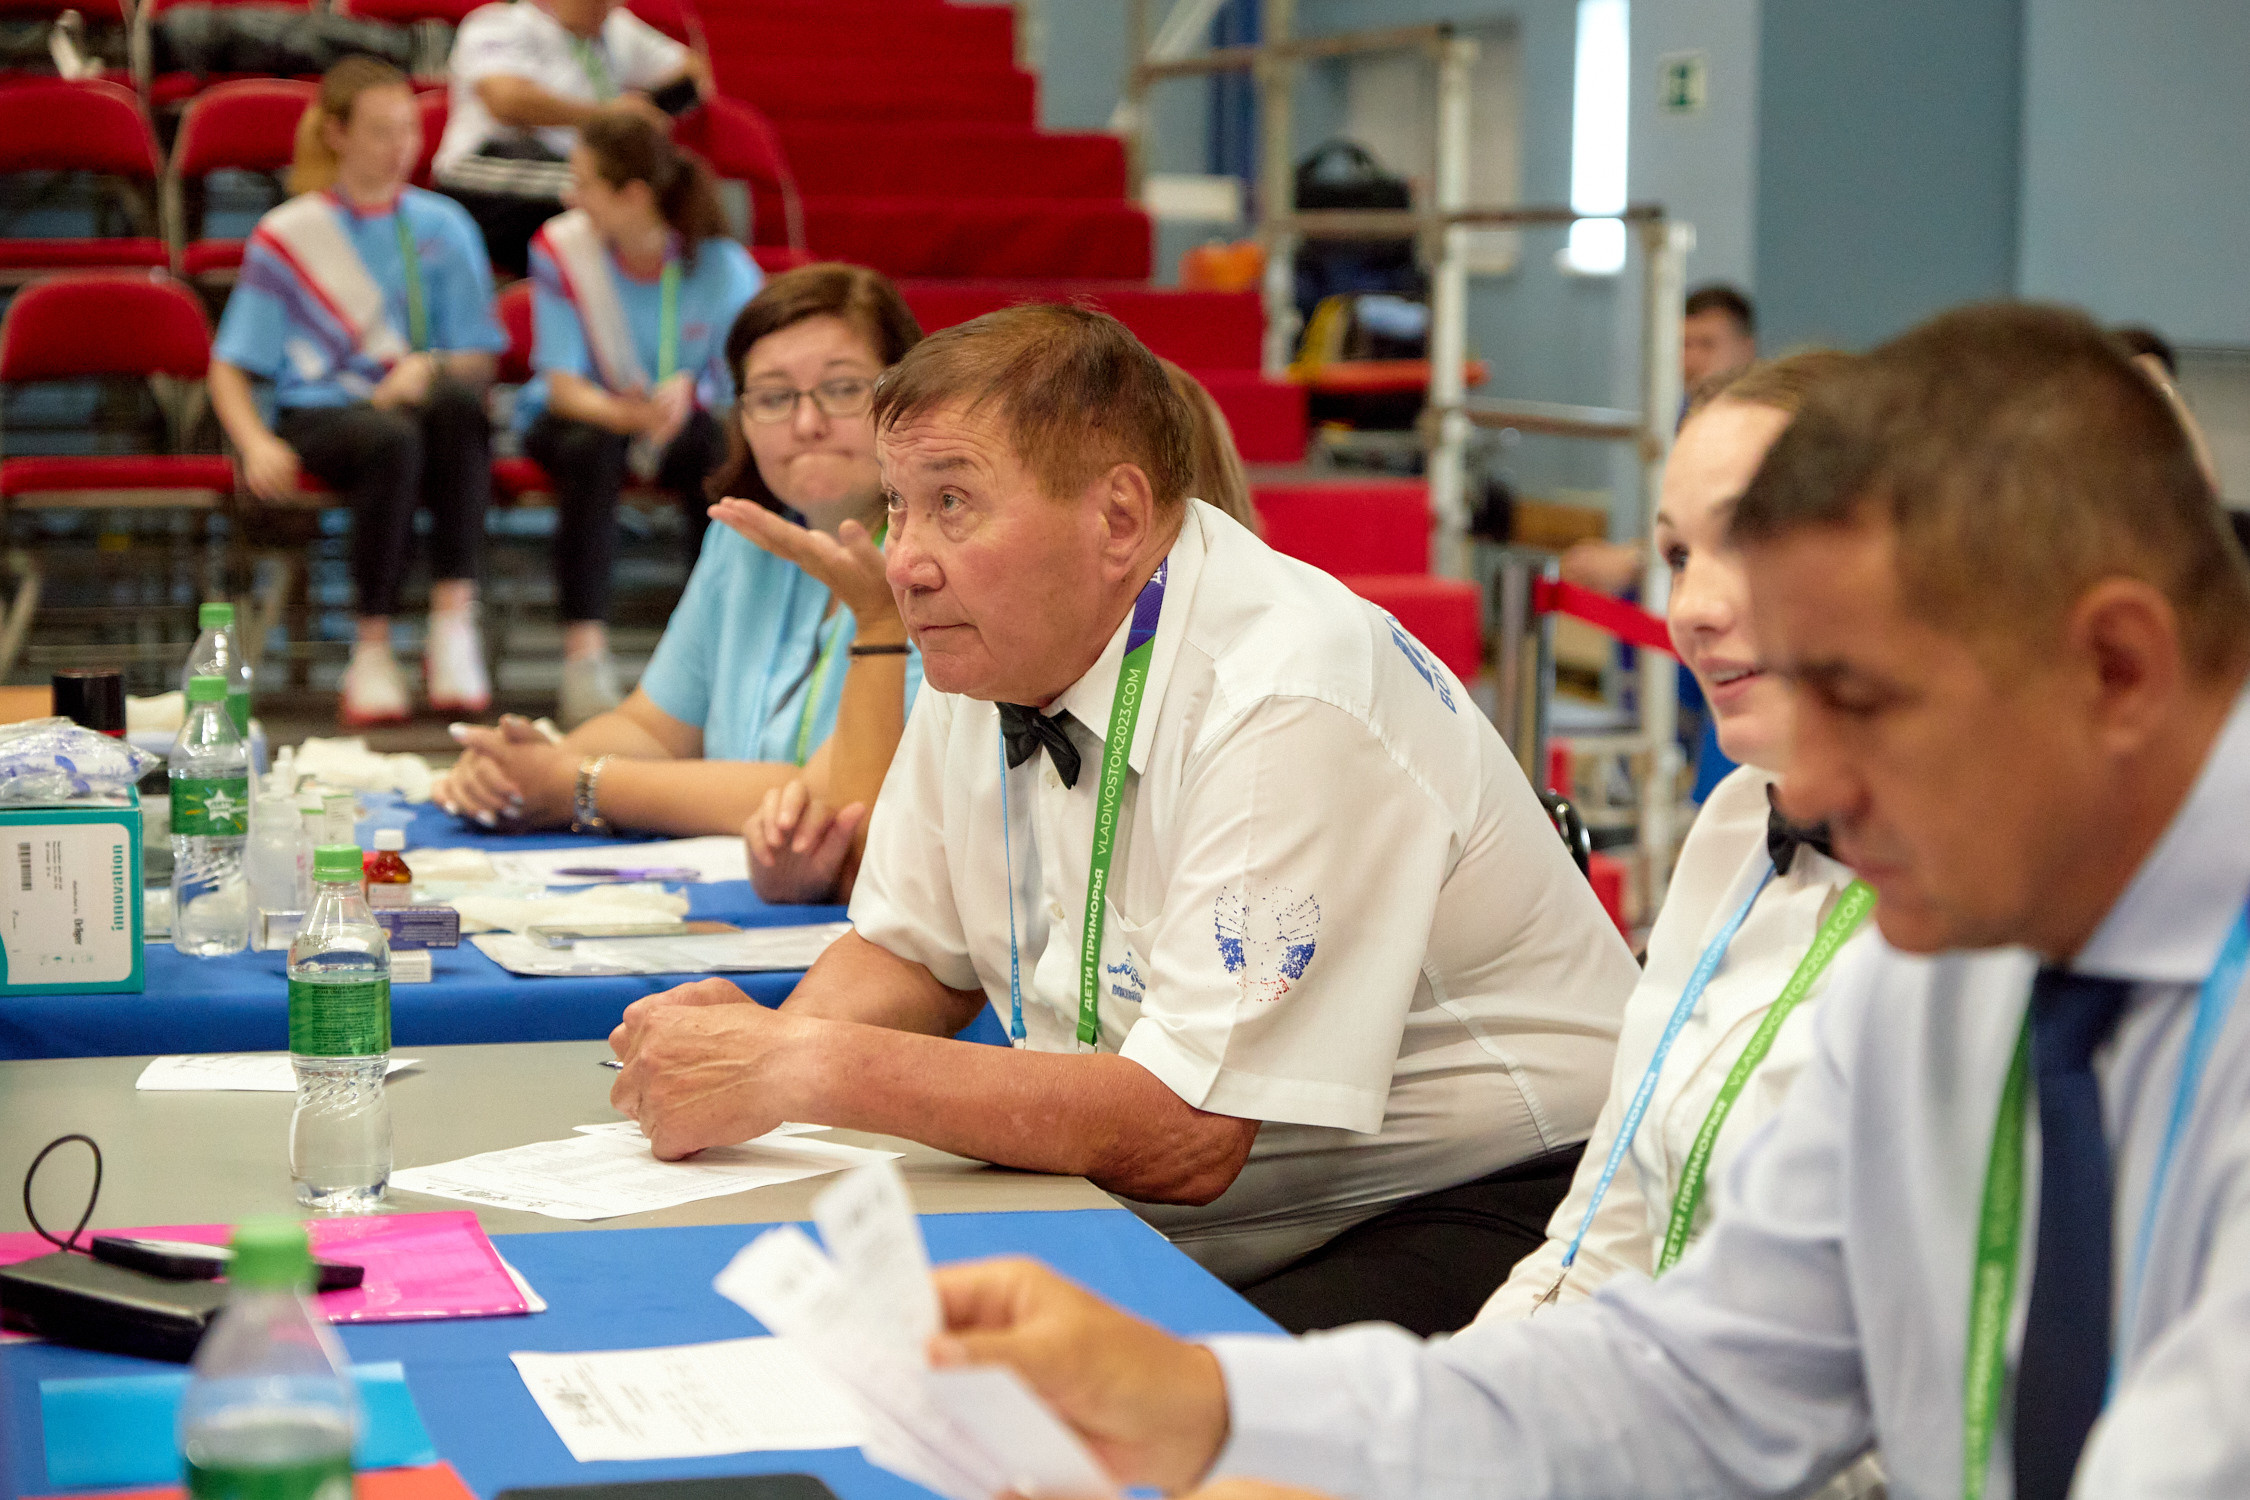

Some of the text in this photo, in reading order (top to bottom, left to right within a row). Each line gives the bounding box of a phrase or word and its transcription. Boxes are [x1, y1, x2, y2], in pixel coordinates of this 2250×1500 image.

[111, 845, 124, 931] innovation
[1084, 668, 1141, 1012] ДЕТИ ПРИМОРЬЯ VLADIVOSTOK2023.COM
[1678, 1100, 1727, 1213] ПРИМОРЬЯ
